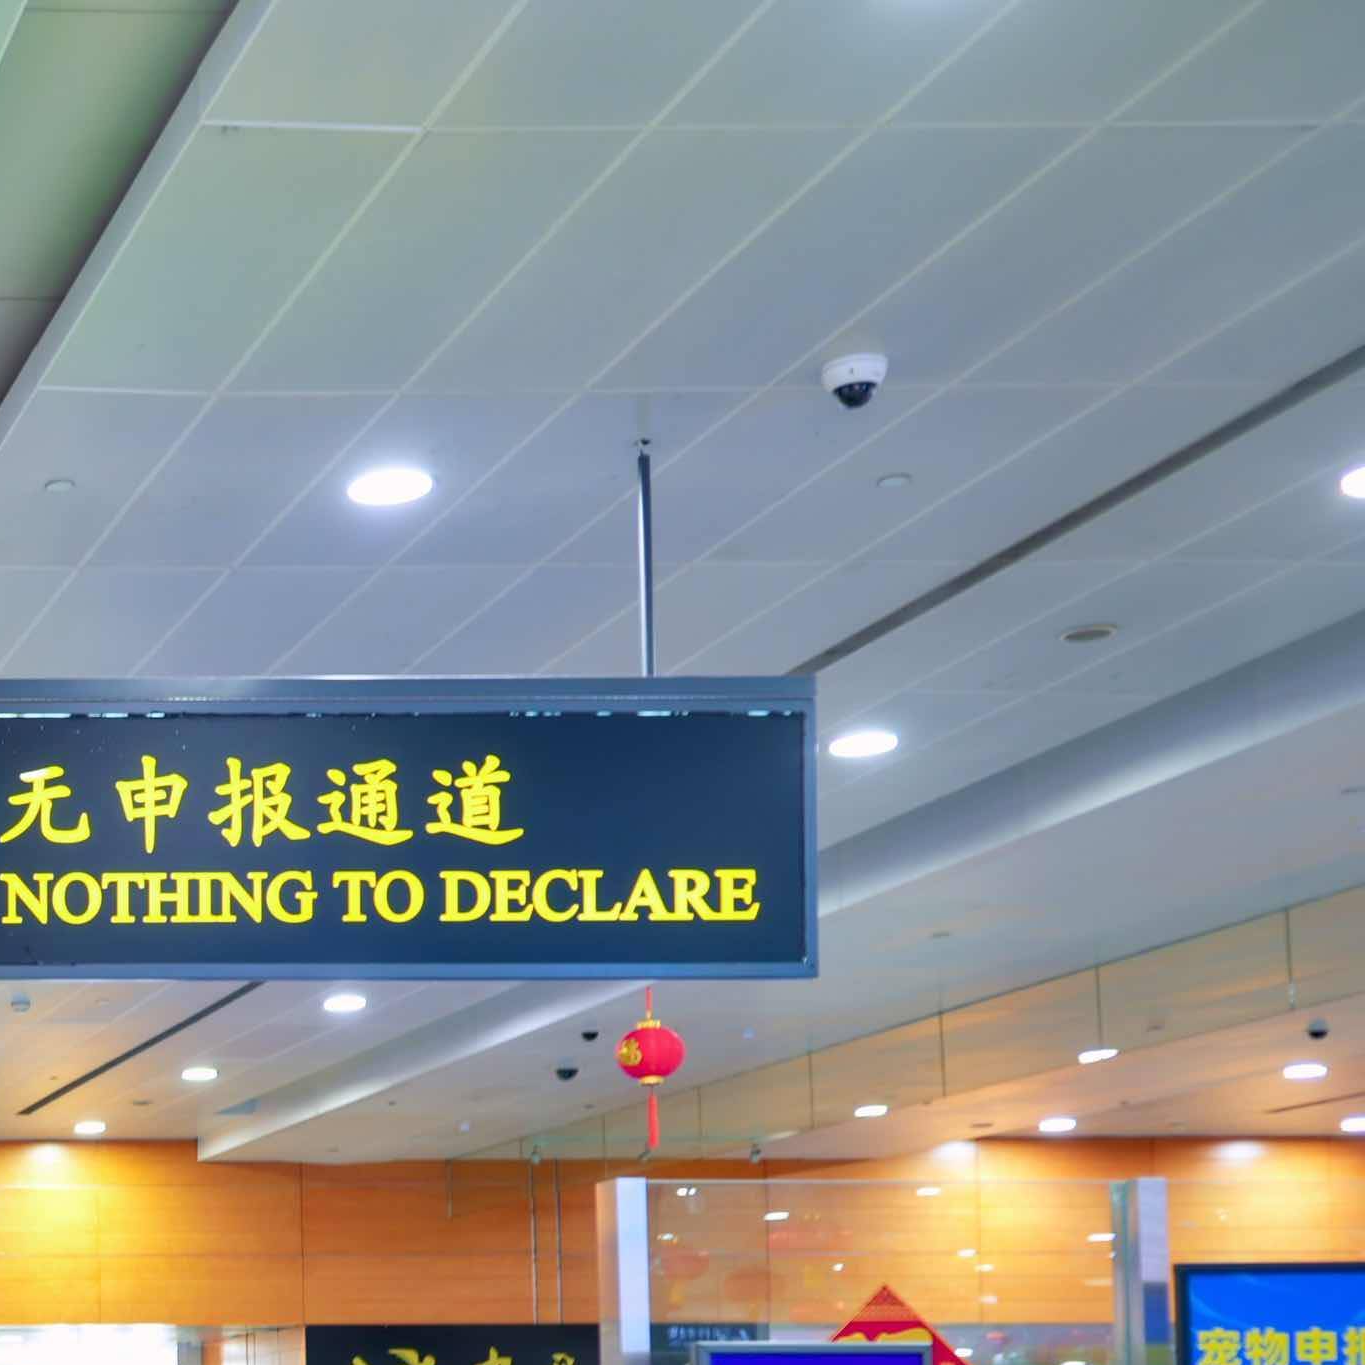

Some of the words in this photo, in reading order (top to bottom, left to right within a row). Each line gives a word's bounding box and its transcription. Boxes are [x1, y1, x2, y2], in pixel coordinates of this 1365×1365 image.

[1, 870, 317, 925] NOTHING
[330, 871, 425, 924] TO
[438, 868, 760, 924] DECLARE
